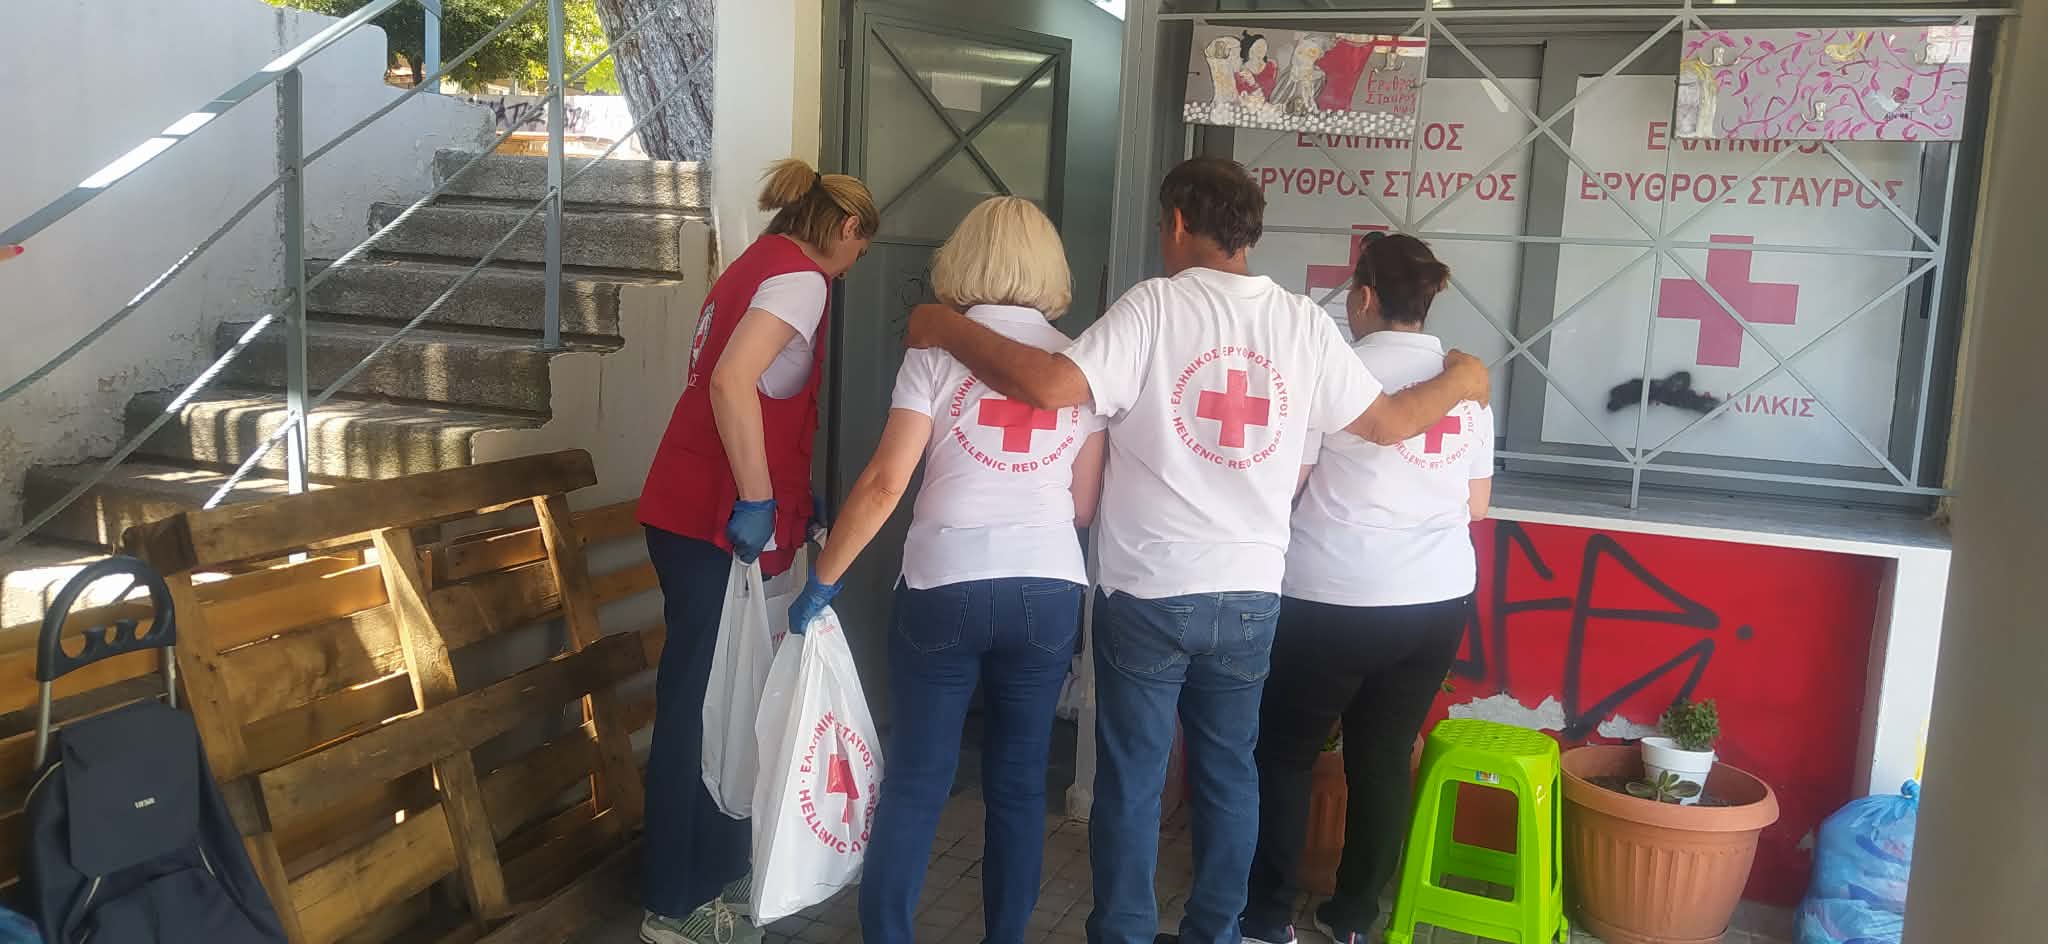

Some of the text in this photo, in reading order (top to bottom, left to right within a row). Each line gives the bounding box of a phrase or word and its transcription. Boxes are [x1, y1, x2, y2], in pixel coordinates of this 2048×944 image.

[1383, 170, 1517, 201] ΣΤΑΥΡΟΣ
[1580, 171, 1904, 209] ΕΡΥΘΡΟΣ ΣΤΑΥΡΟΣ
[1171, 348, 1220, 405] ΕΛΛΗΝΙΚΟΣ
[952, 426, 1074, 473] HELLENIC RED CROSS
[1172, 416, 1224, 465] HELLENIC
[799, 788, 847, 854] HELLENIC
